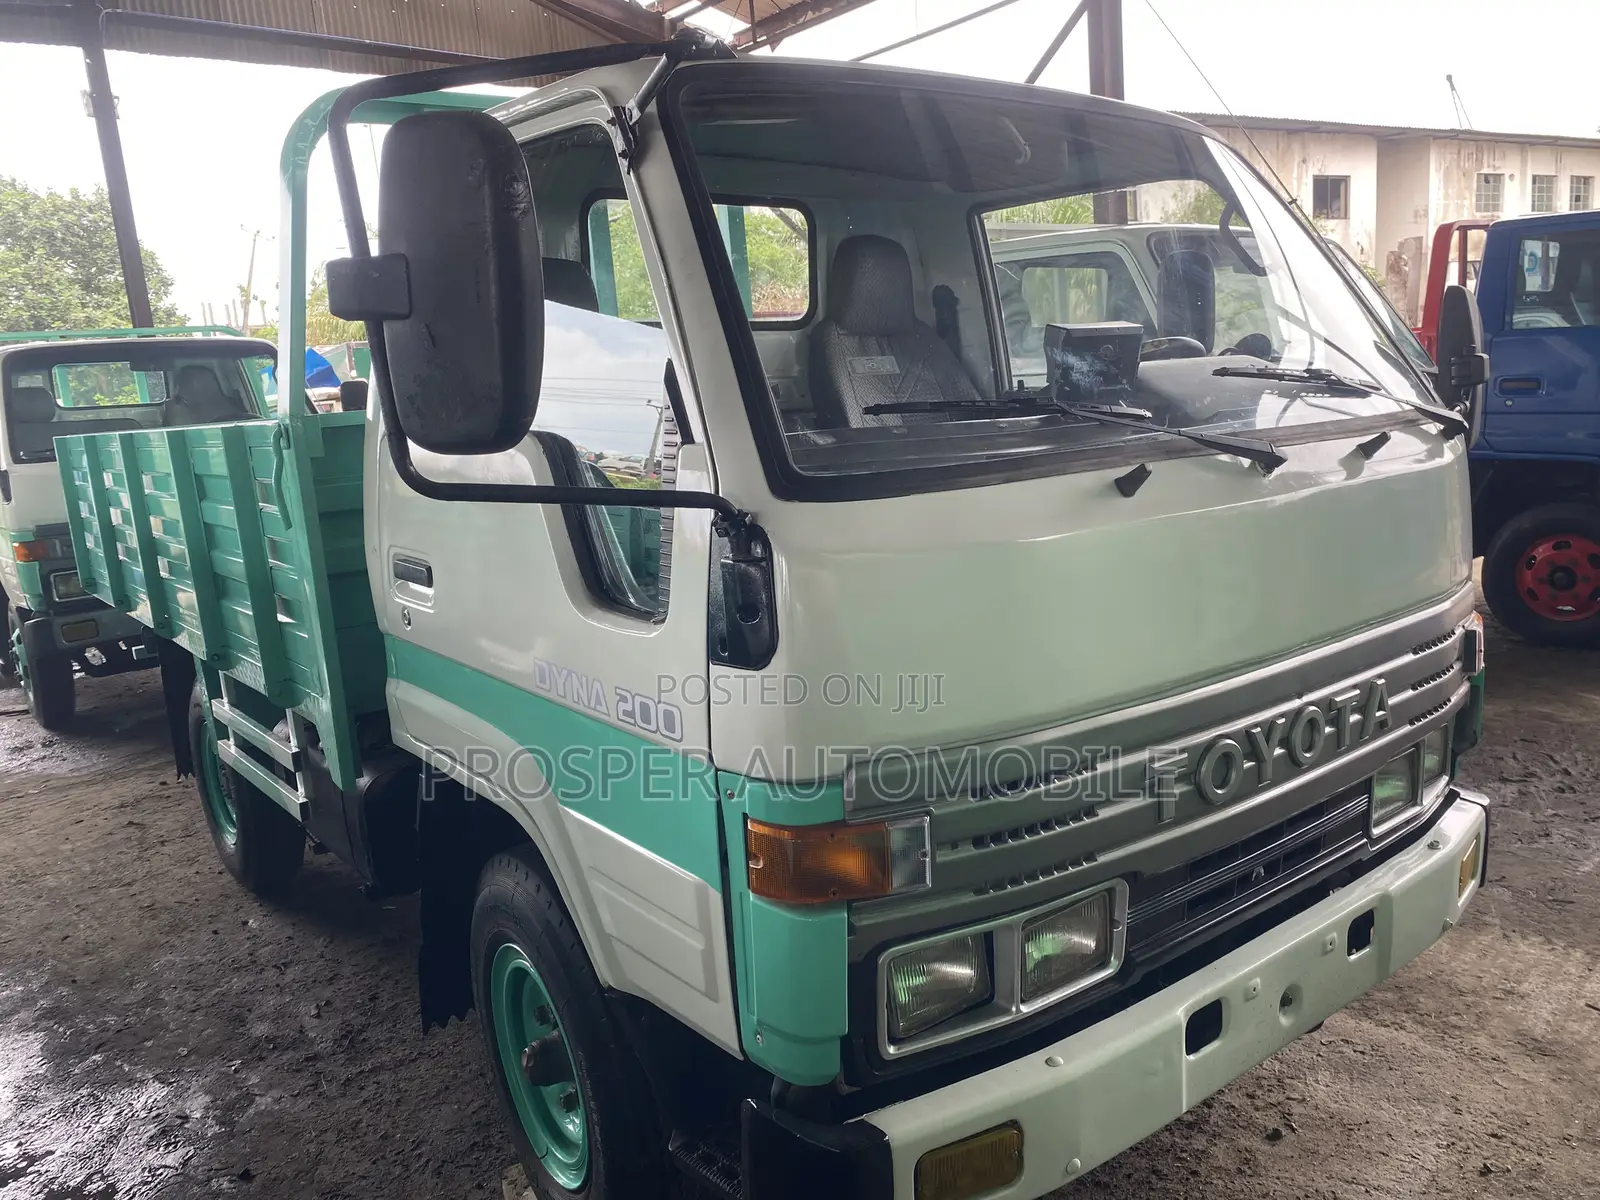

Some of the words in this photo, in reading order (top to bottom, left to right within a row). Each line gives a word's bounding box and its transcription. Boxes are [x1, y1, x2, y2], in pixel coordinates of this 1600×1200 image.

[533, 656, 609, 716] DYNA
[615, 687, 683, 743] 200
[1145, 677, 1394, 824] TOYOTA
